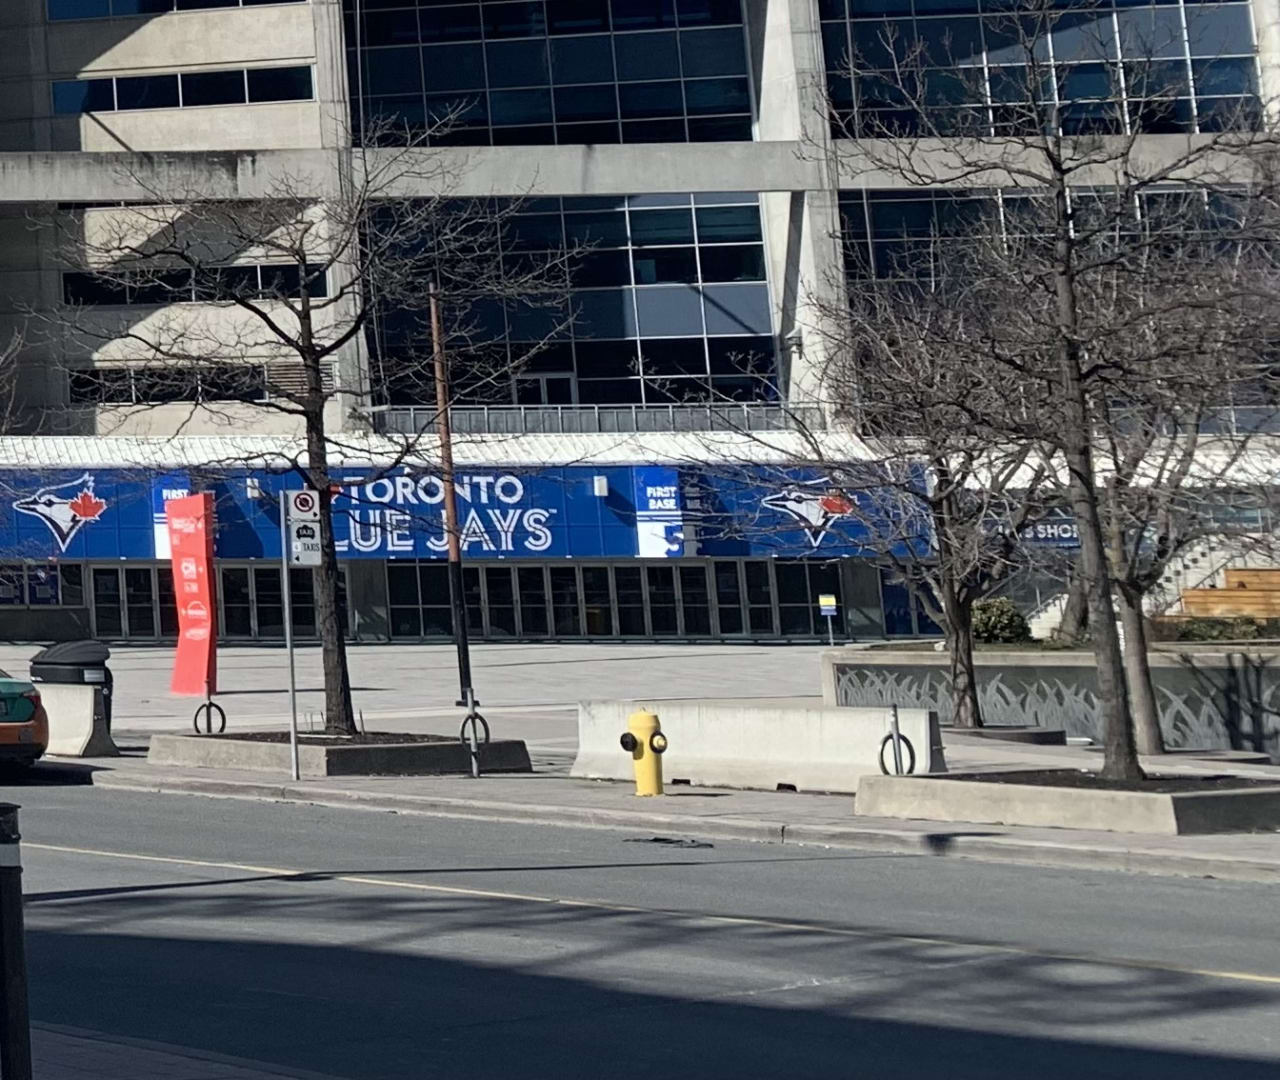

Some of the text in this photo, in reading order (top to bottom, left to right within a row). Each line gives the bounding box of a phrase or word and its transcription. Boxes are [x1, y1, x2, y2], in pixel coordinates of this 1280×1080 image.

[343, 475, 523, 504] TORONTO
[646, 486, 677, 497] FIRST
[648, 499, 677, 510] BASE
[426, 508, 552, 551] JAYS
[302, 543, 320, 552] TAXIS
